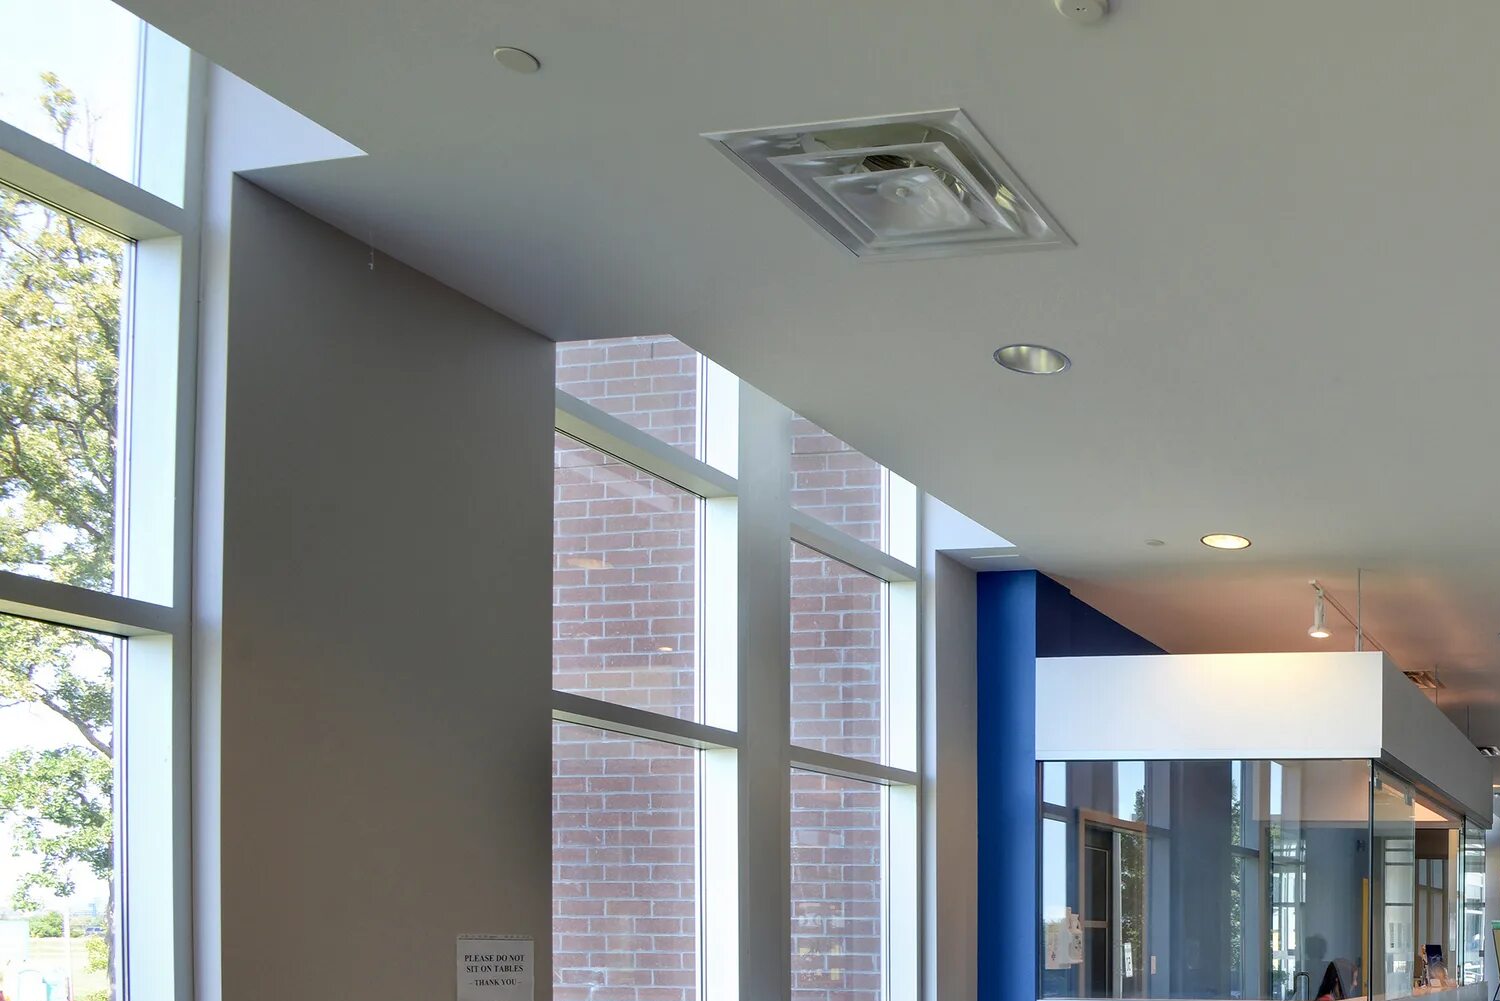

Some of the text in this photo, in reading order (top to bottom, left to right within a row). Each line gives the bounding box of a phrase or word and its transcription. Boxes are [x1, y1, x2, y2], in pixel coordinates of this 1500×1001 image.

[464, 954, 494, 962] PLEASE
[466, 965, 478, 973] SIT
[480, 965, 492, 973] ON
